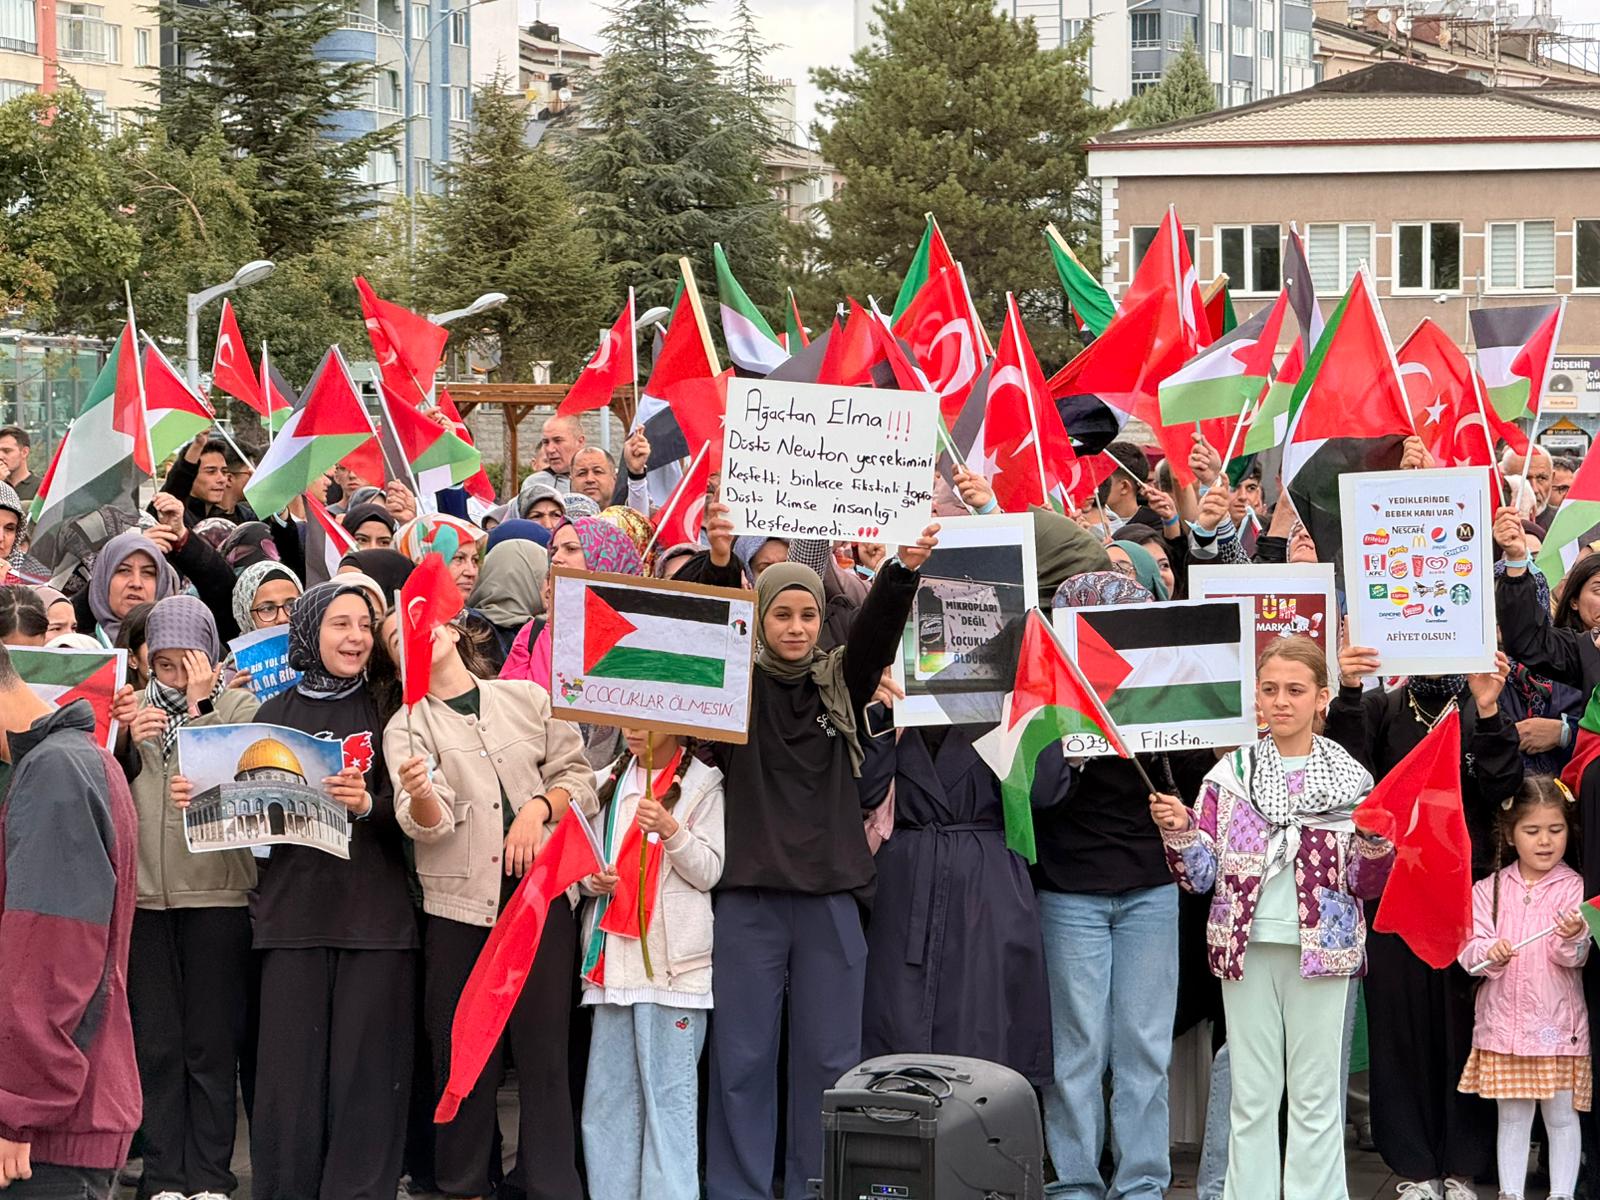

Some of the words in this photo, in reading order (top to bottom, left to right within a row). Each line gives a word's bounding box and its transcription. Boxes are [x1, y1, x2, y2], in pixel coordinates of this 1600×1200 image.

[1552, 360, 1590, 370] DİŞEHİR
[745, 388, 817, 431] Ağaçtan
[777, 434, 849, 463] Newton
[790, 469, 844, 490] binlerce
[1388, 495, 1450, 505] YEDİKLERİNDE
[776, 490, 817, 511] Kimse
[833, 497, 897, 526] insanlığı
[1385, 510, 1412, 518] BEBEK
[1414, 509, 1435, 517] KANI
[1436, 509, 1454, 517] VAR
[961, 616, 987, 627] DEĞİL
[1256, 622, 1309, 632] MARKALAR
[1386, 631, 1420, 641] AFİYET
[264, 657, 279, 668] YOL
[585, 684, 664, 710] ÇOCUKLAR
[1066, 735, 1110, 753] Özg
